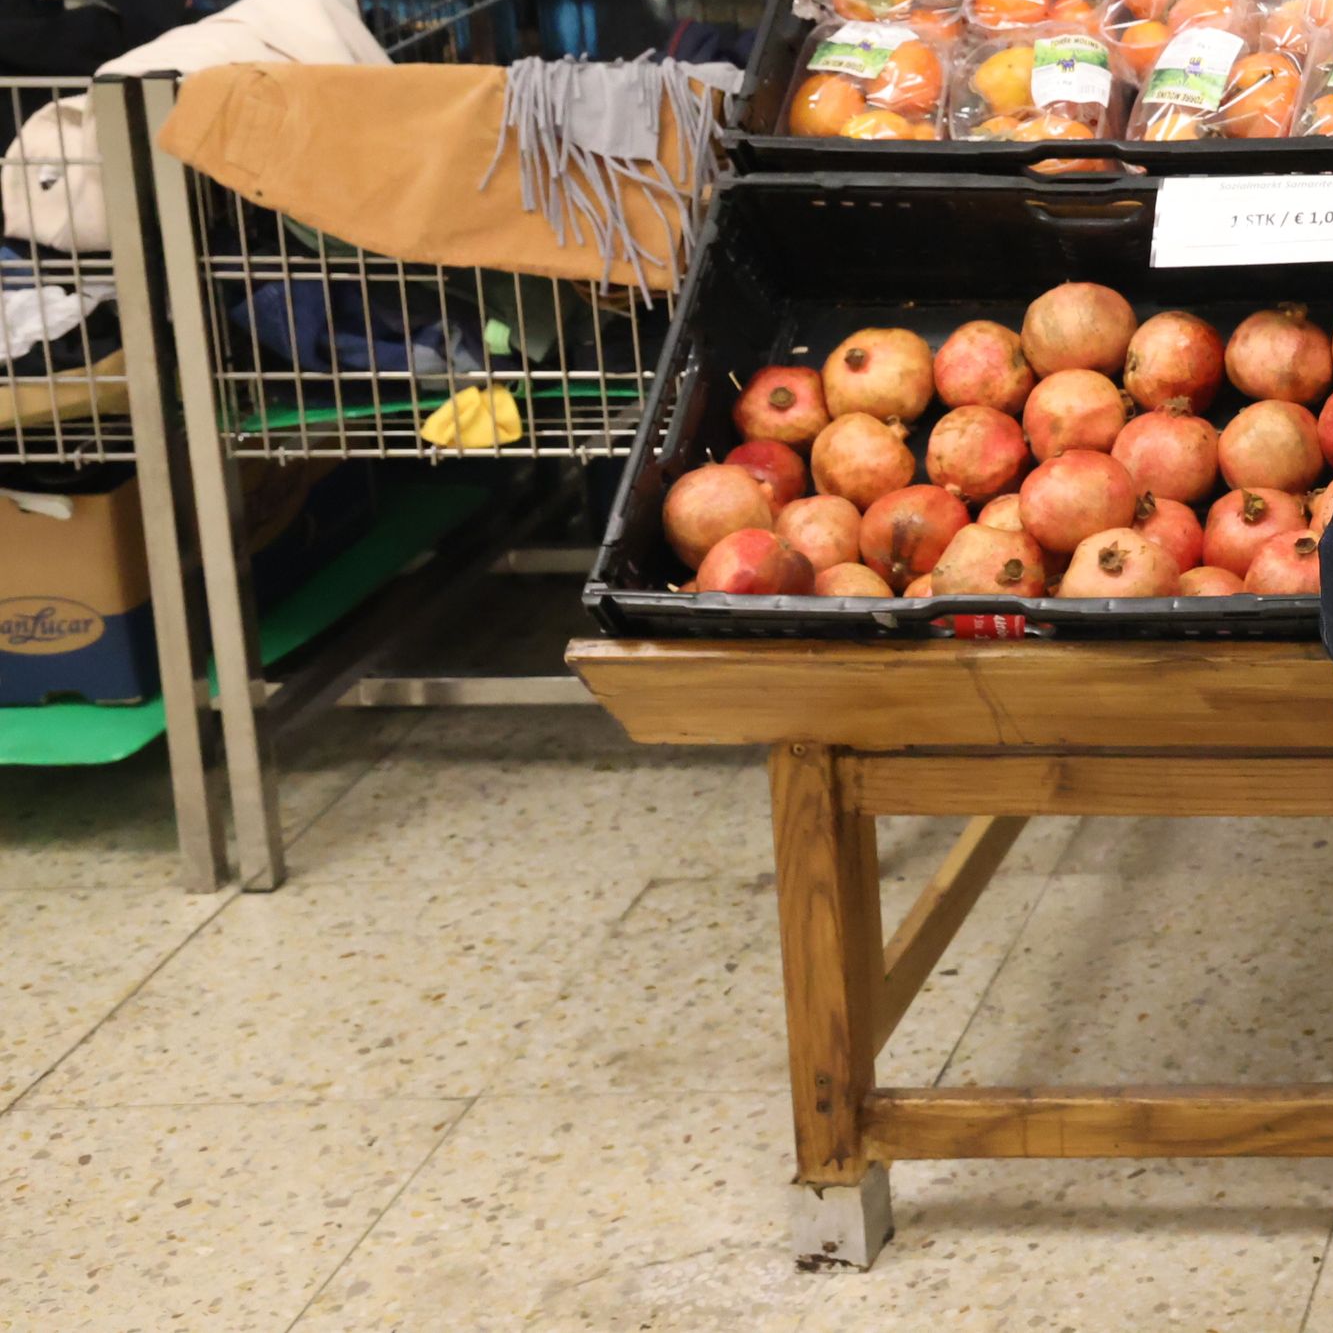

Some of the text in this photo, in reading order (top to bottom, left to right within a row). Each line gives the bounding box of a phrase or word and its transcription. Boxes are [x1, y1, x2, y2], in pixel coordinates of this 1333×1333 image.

[1219, 181, 1282, 191] Sozialmarkt
[1246, 213, 1275, 226] STK
[1294, 212, 1304, 225] €
